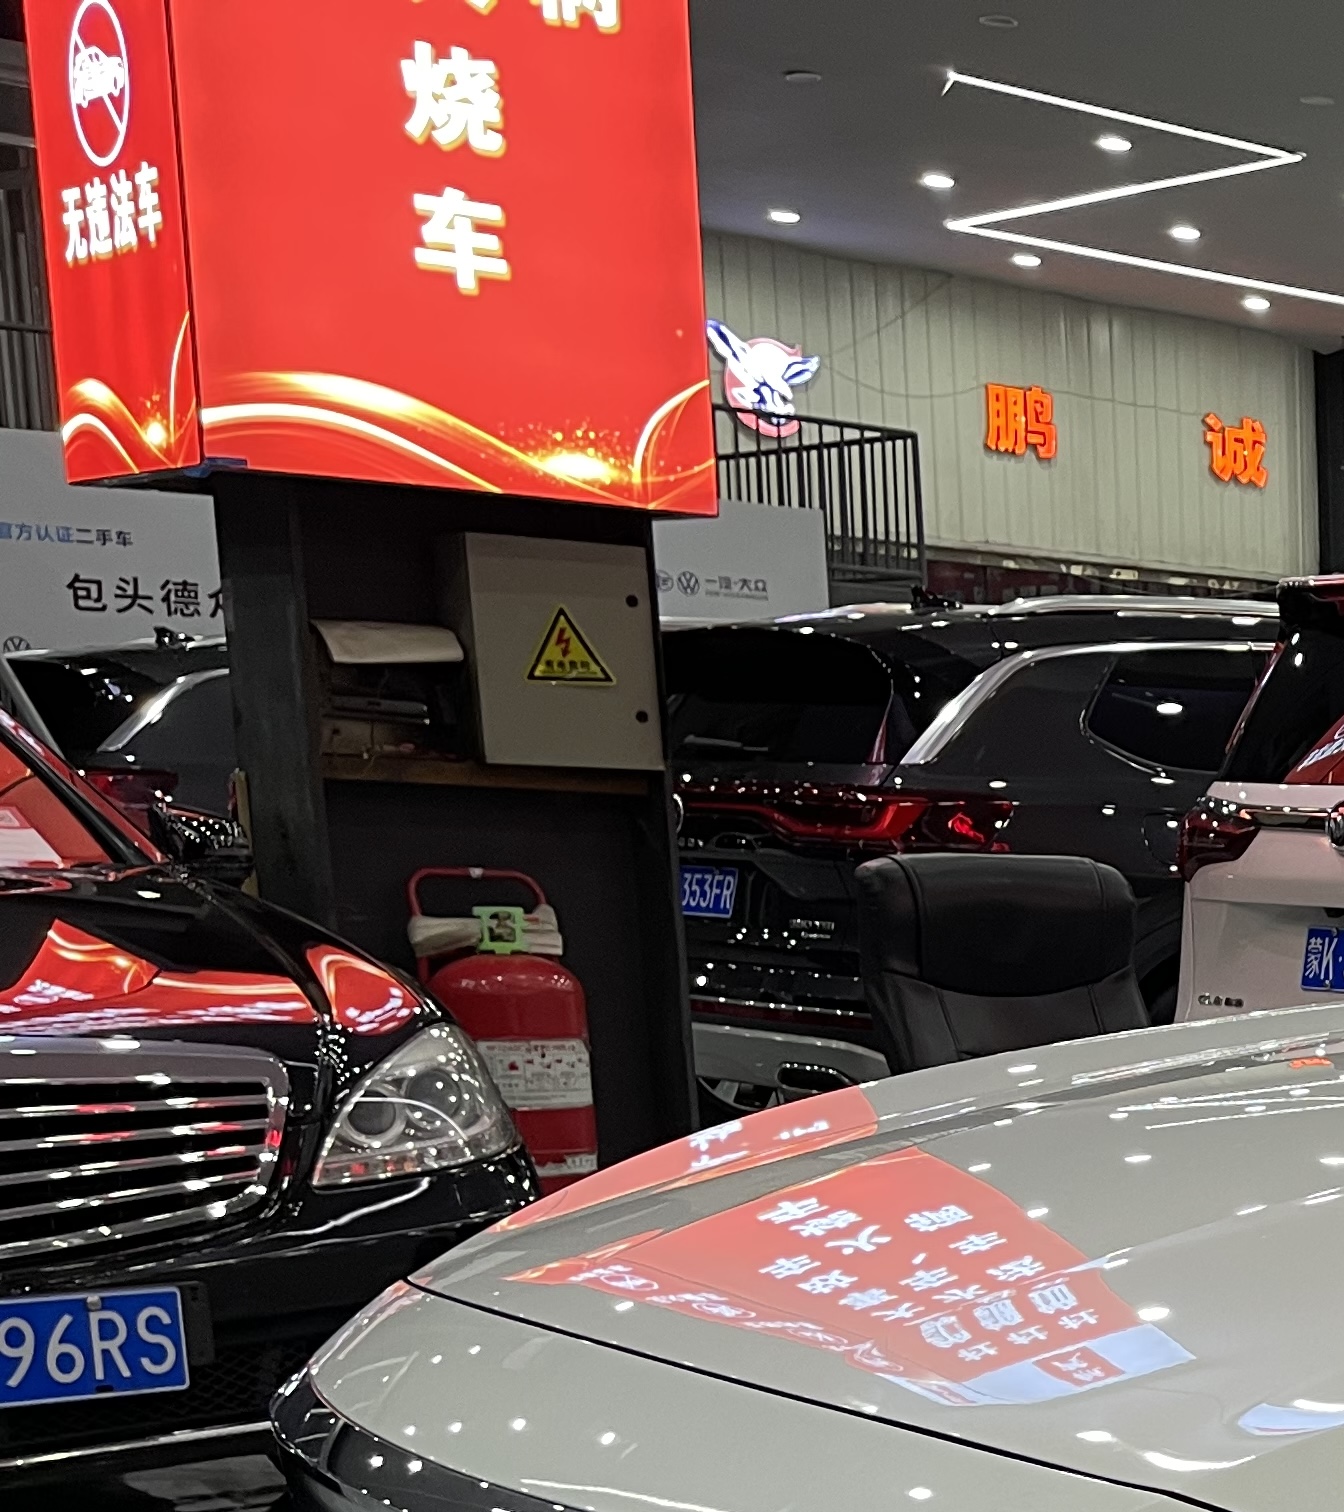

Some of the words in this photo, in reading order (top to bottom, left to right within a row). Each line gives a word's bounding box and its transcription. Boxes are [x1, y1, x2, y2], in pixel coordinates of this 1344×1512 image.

[400, 0, 512, 296] 烧车
[61, 161, 163, 268] 无违法车
[682, 873, 734, 909] 353FR
[0, 1306, 176, 1388] 96RS
